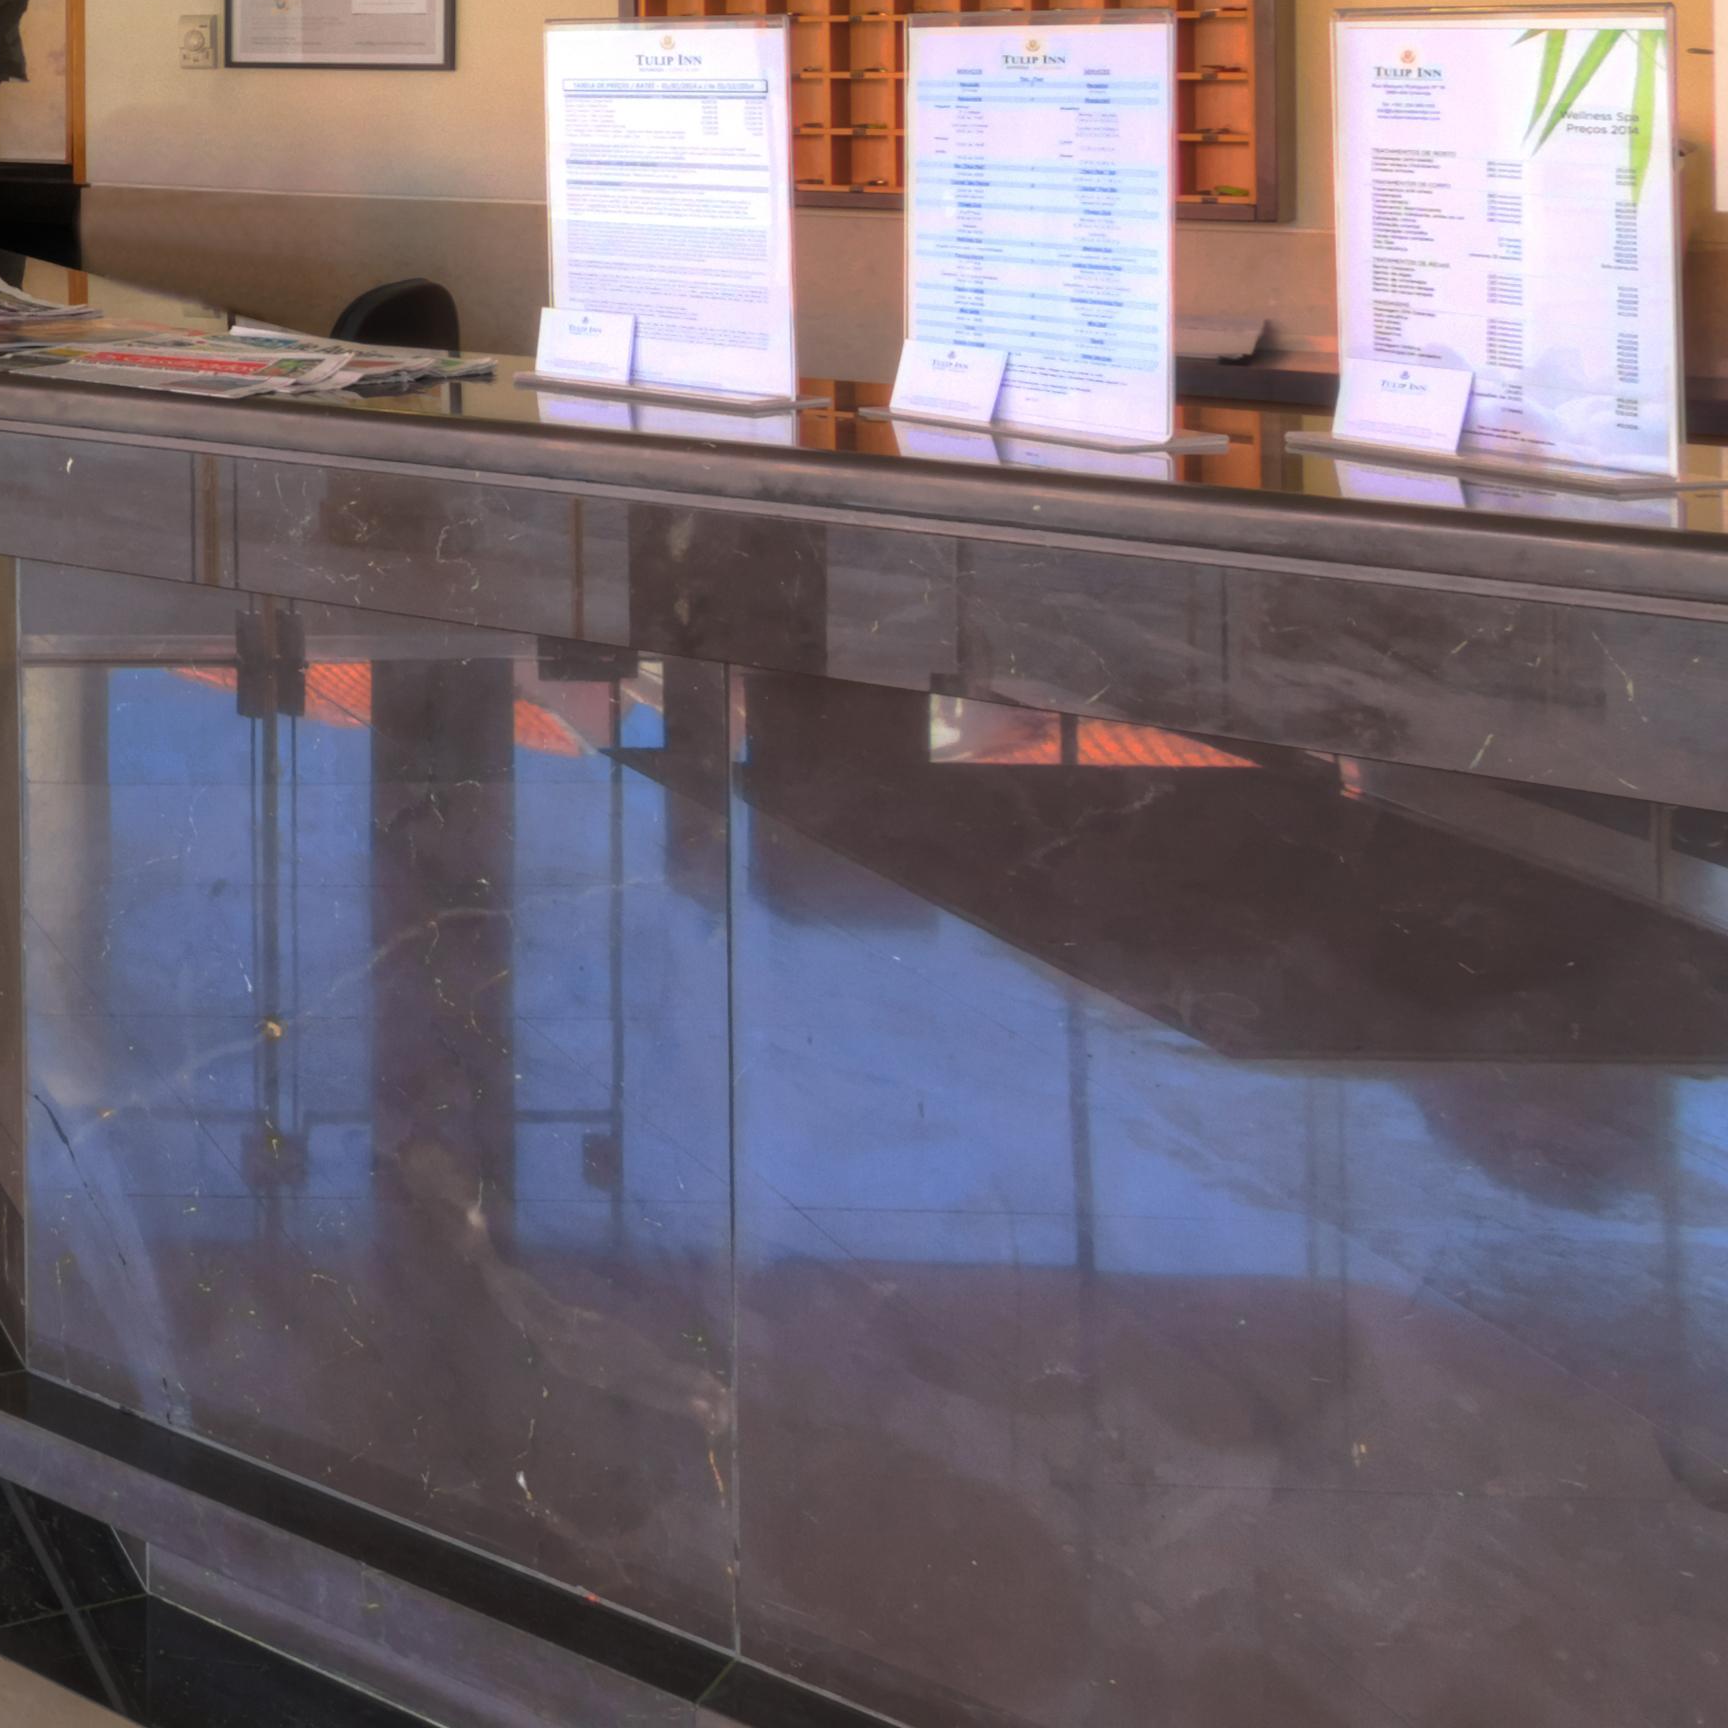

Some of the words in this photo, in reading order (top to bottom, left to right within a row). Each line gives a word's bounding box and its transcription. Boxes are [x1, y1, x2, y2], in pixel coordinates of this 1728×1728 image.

[635, 54, 674, 66] TULIP
[677, 54, 703, 65] INN
[1002, 54, 1039, 64] TULIP
[1043, 55, 1066, 64] INN
[1374, 66, 1413, 77] TULIP
[1417, 67, 1442, 77] INN
[1616, 112, 1640, 122] Spa
[1566, 123, 1608, 134] Preços
